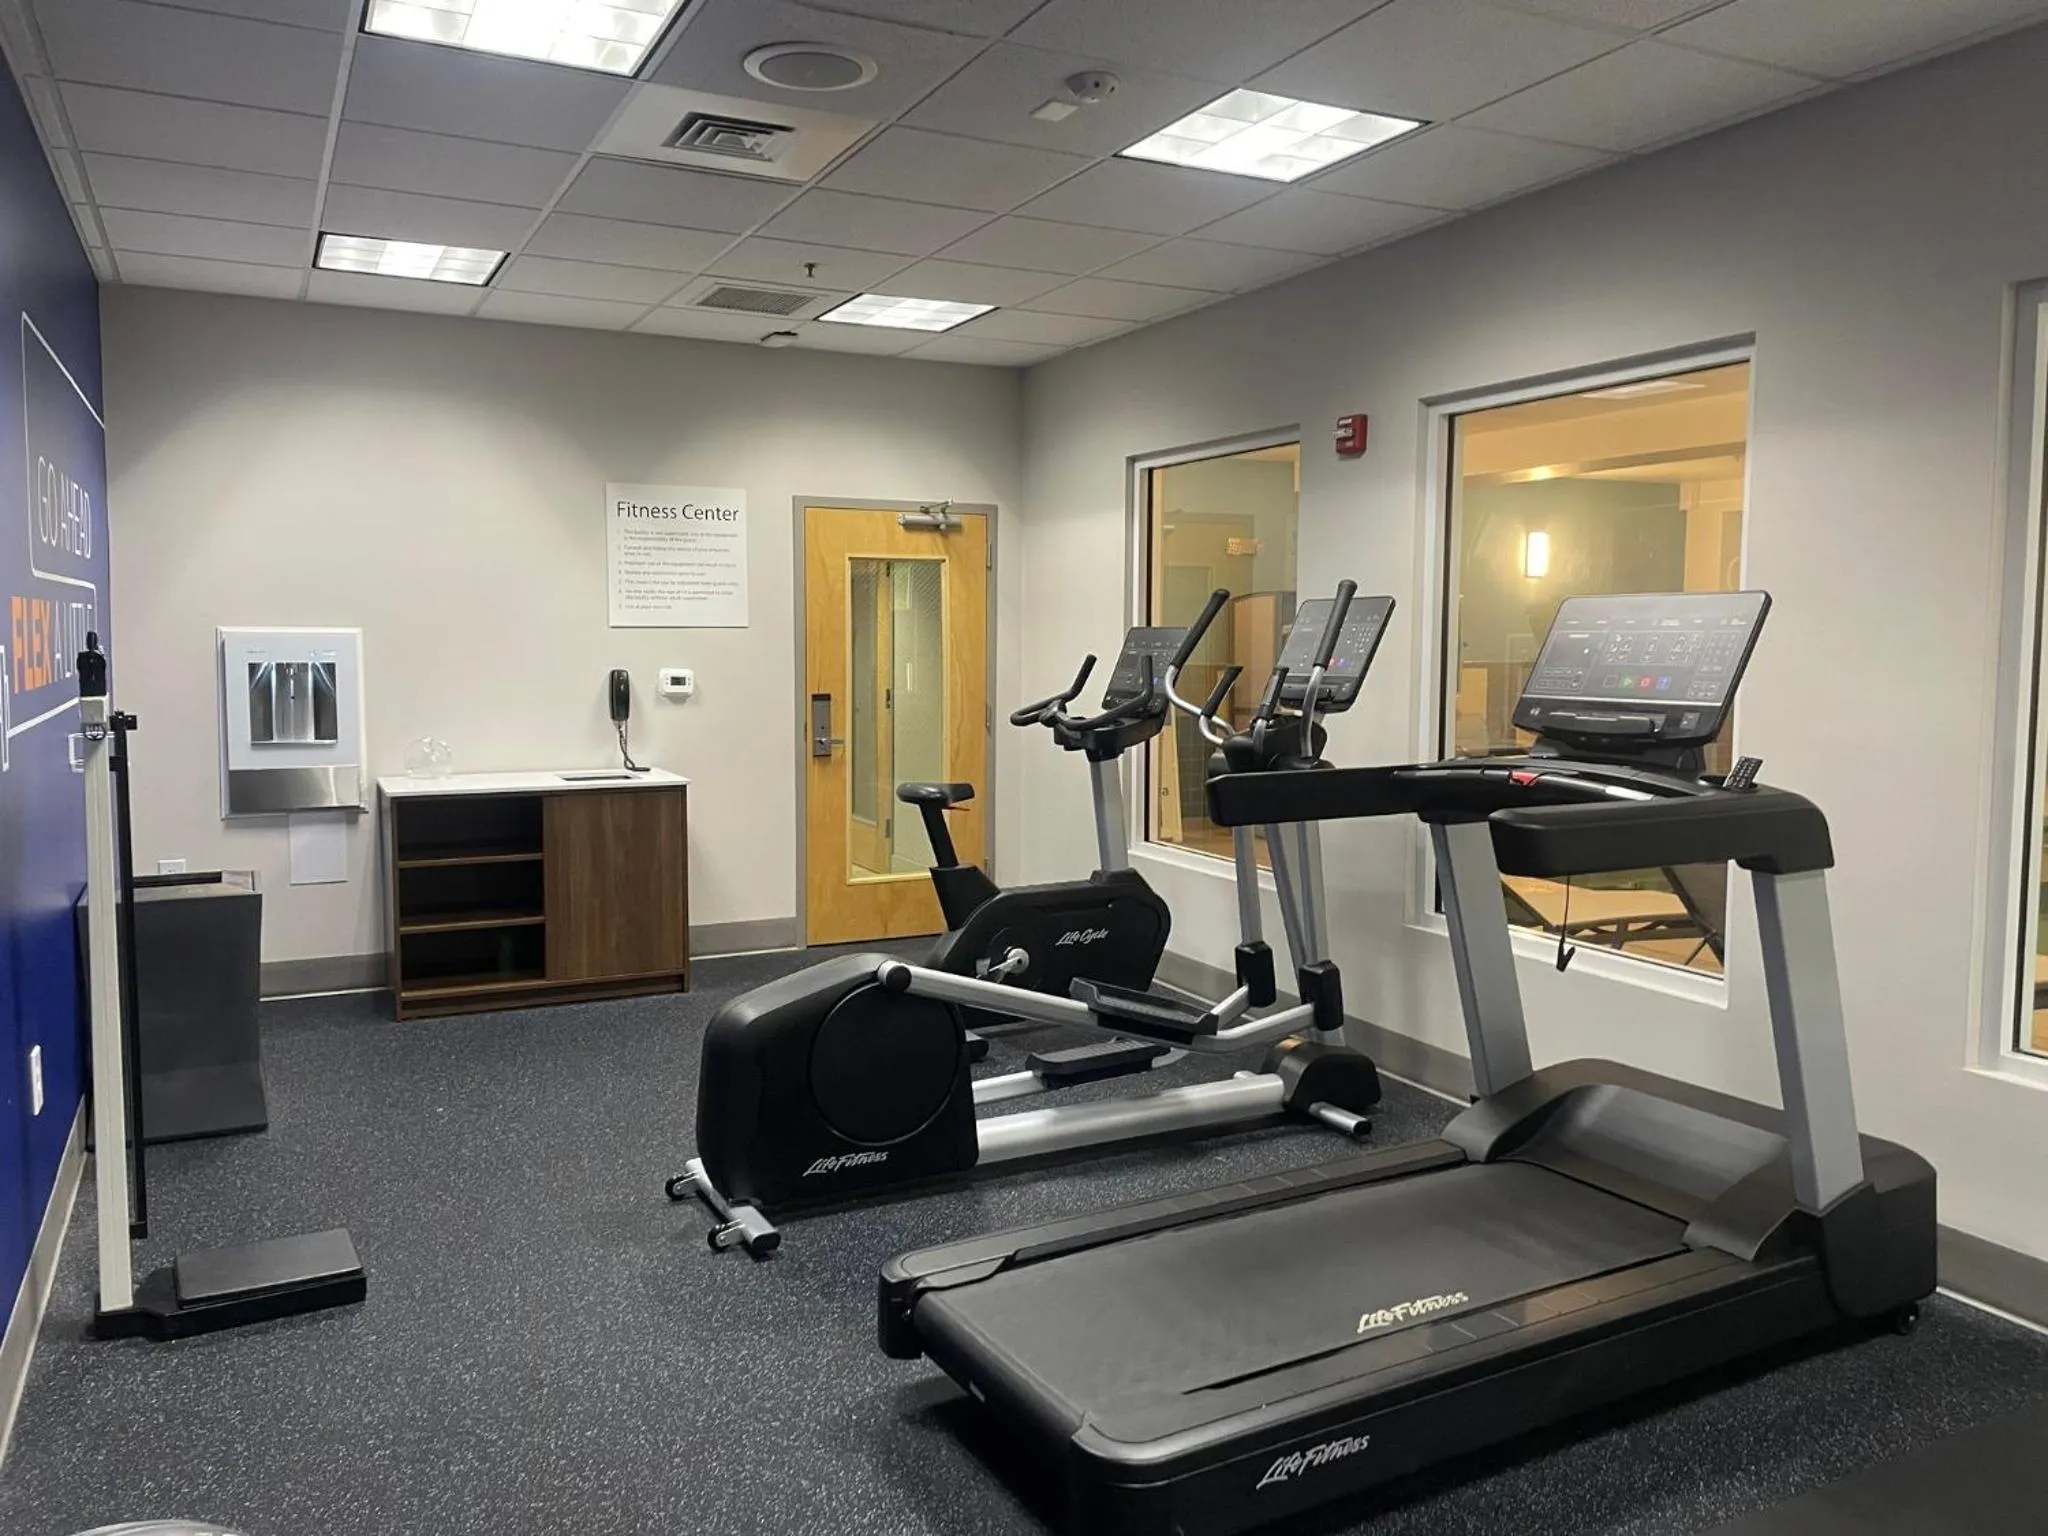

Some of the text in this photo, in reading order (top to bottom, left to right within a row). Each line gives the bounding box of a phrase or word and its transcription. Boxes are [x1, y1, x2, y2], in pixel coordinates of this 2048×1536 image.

[37, 456, 91, 559] GO AHEAD
[616, 501, 739, 521] Fitness Center
[11, 596, 52, 694] FLEX
